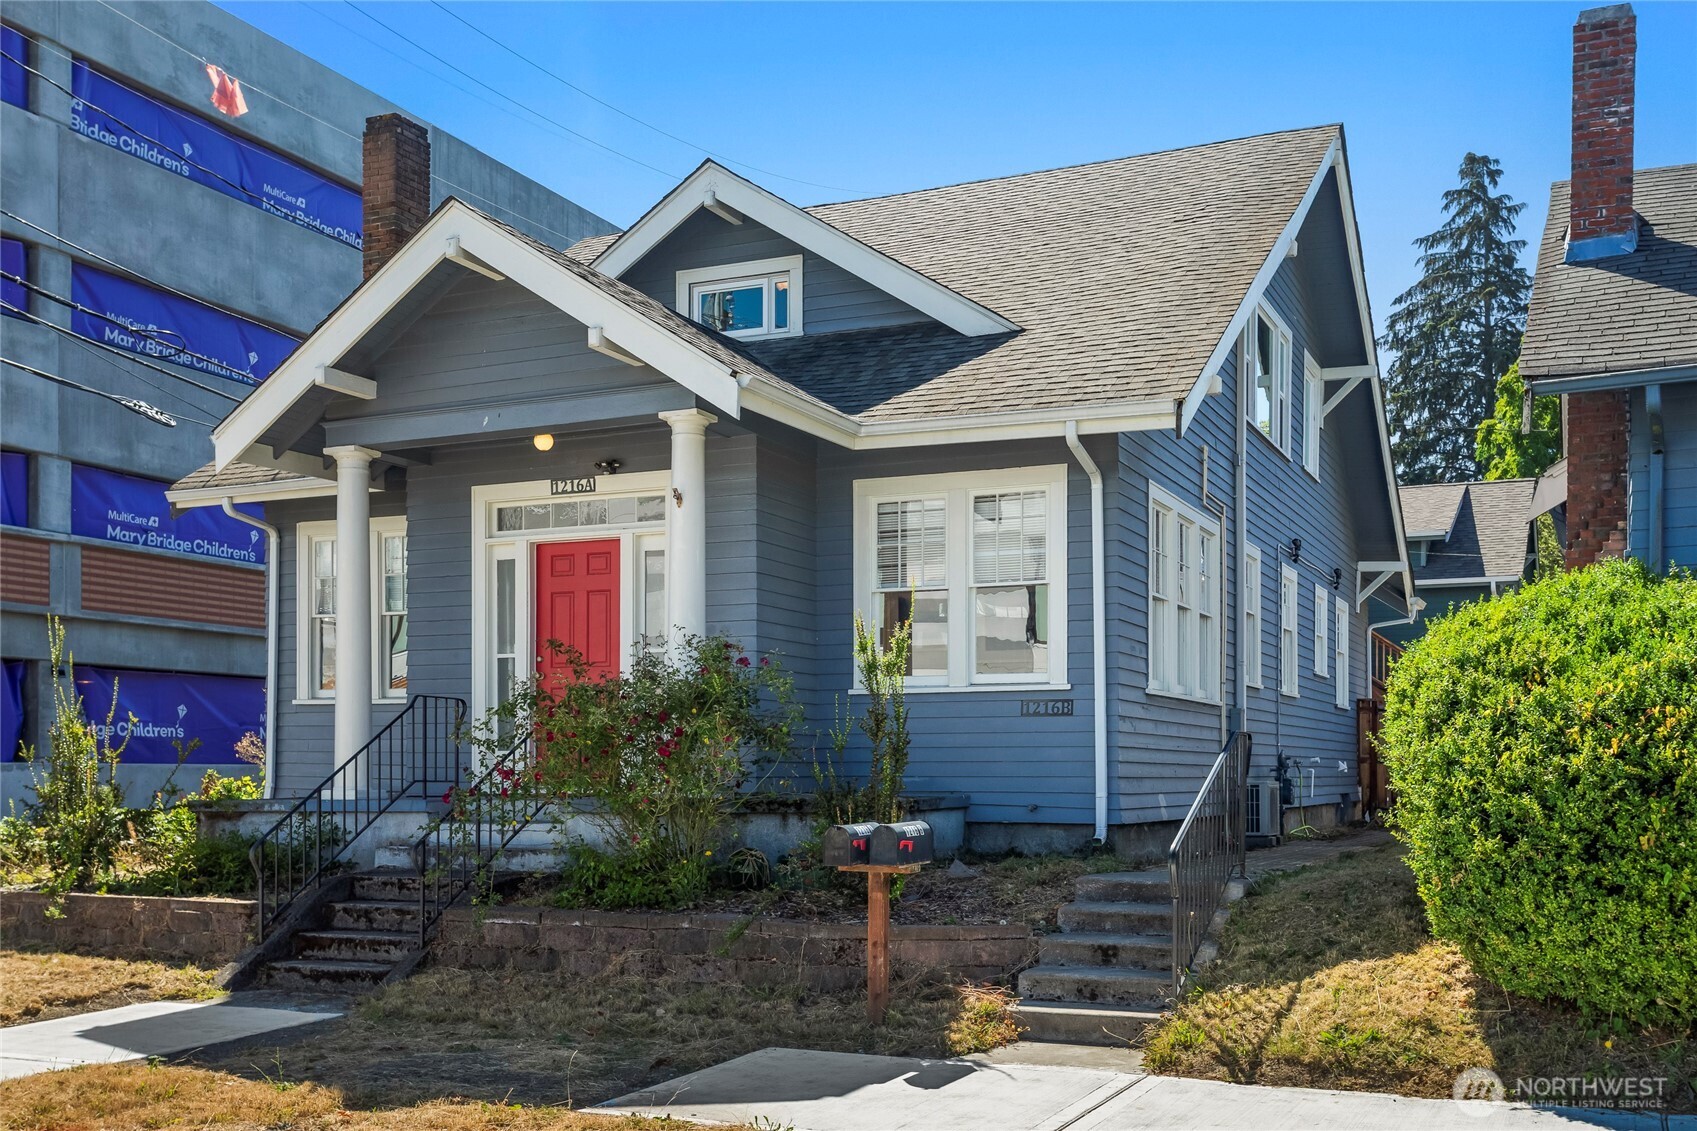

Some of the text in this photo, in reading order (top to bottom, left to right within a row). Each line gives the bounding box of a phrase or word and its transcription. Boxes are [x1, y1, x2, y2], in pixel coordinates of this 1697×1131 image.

[120, 136, 190, 176] Children's
[264, 184, 296, 204] MultiCare
[334, 228, 364, 250] Child
[106, 312, 146, 331] MultiCare
[104, 326, 145, 353] Mary
[553, 479, 594, 494] 1216A
[108, 510, 148, 526] MultiCare
[106, 524, 256, 562] Mary Bridge Children's
[1023, 700, 1072, 716] 1216B
[116, 721, 184, 738] Children's
